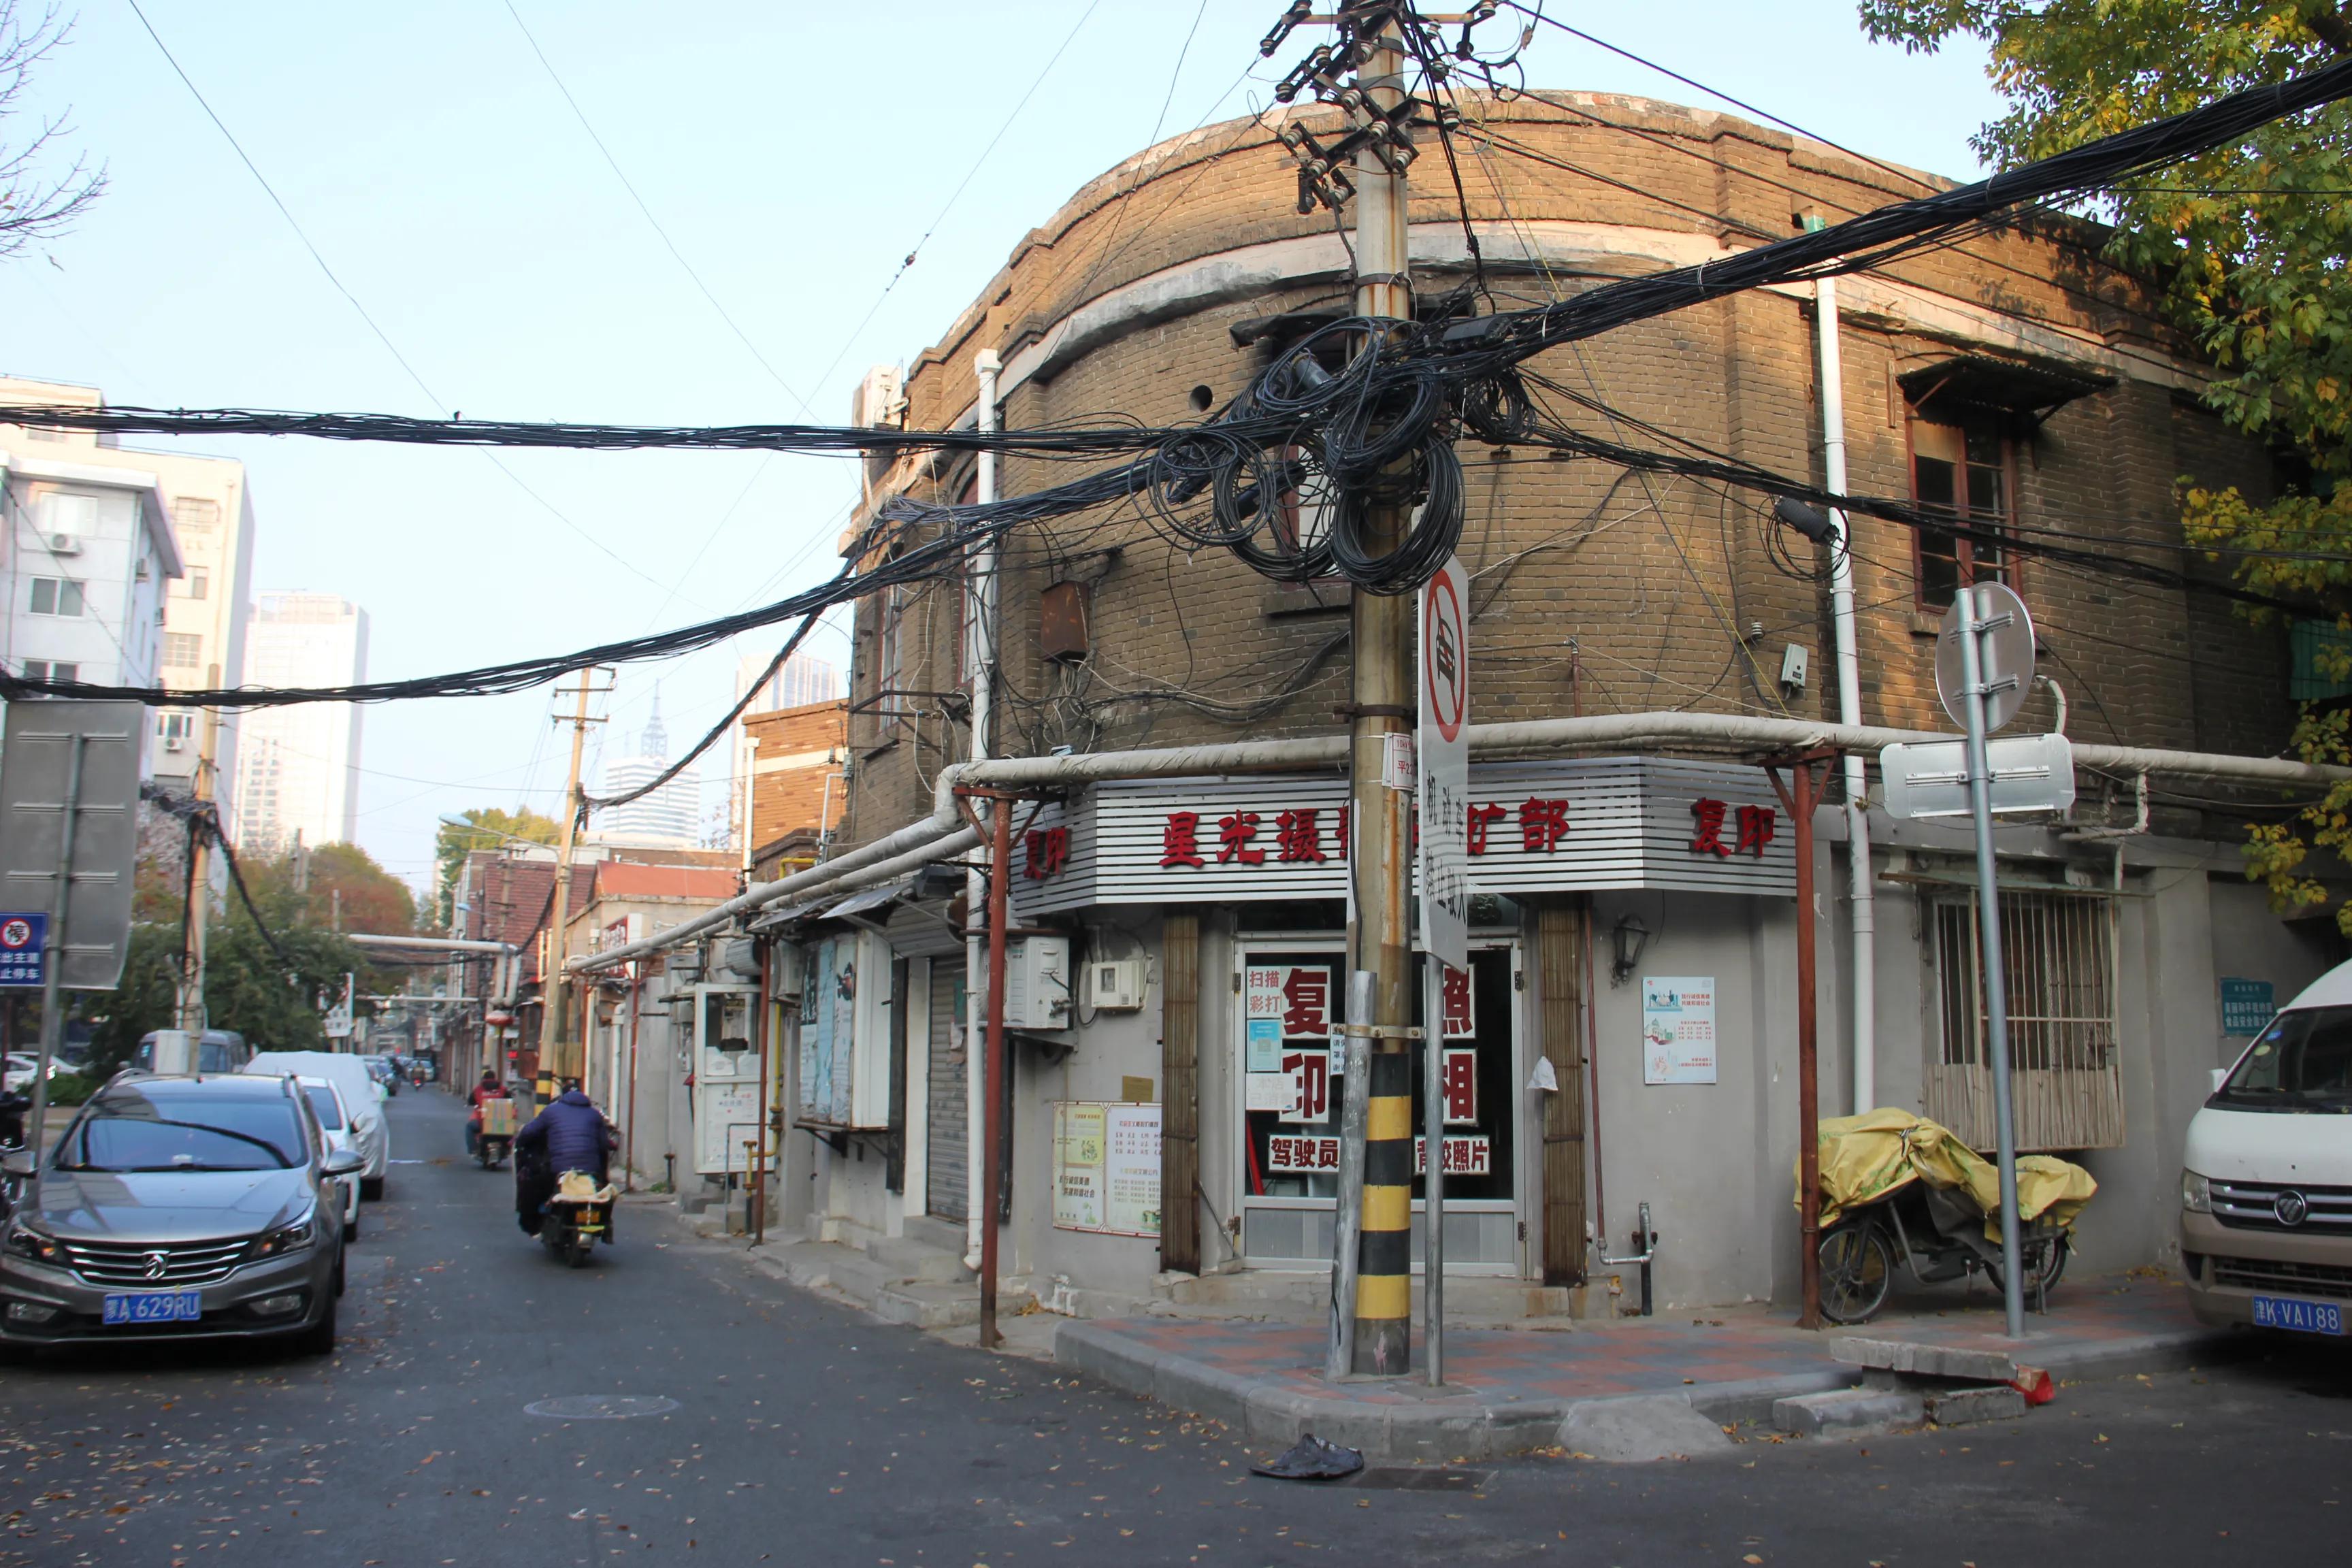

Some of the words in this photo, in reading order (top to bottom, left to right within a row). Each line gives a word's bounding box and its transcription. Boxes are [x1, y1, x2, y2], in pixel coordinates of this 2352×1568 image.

[1159, 796, 1570, 868] 星光摄扩部
[1427, 770, 1463, 847] 机动车
[1693, 798, 1776, 858] 复印
[1250, 970, 1280, 987] 扫描
[1250, 994, 1281, 1013] 彩打
[1281, 968, 1329, 1119] 复印
[1271, 1139, 1339, 1169] 驾驶员
